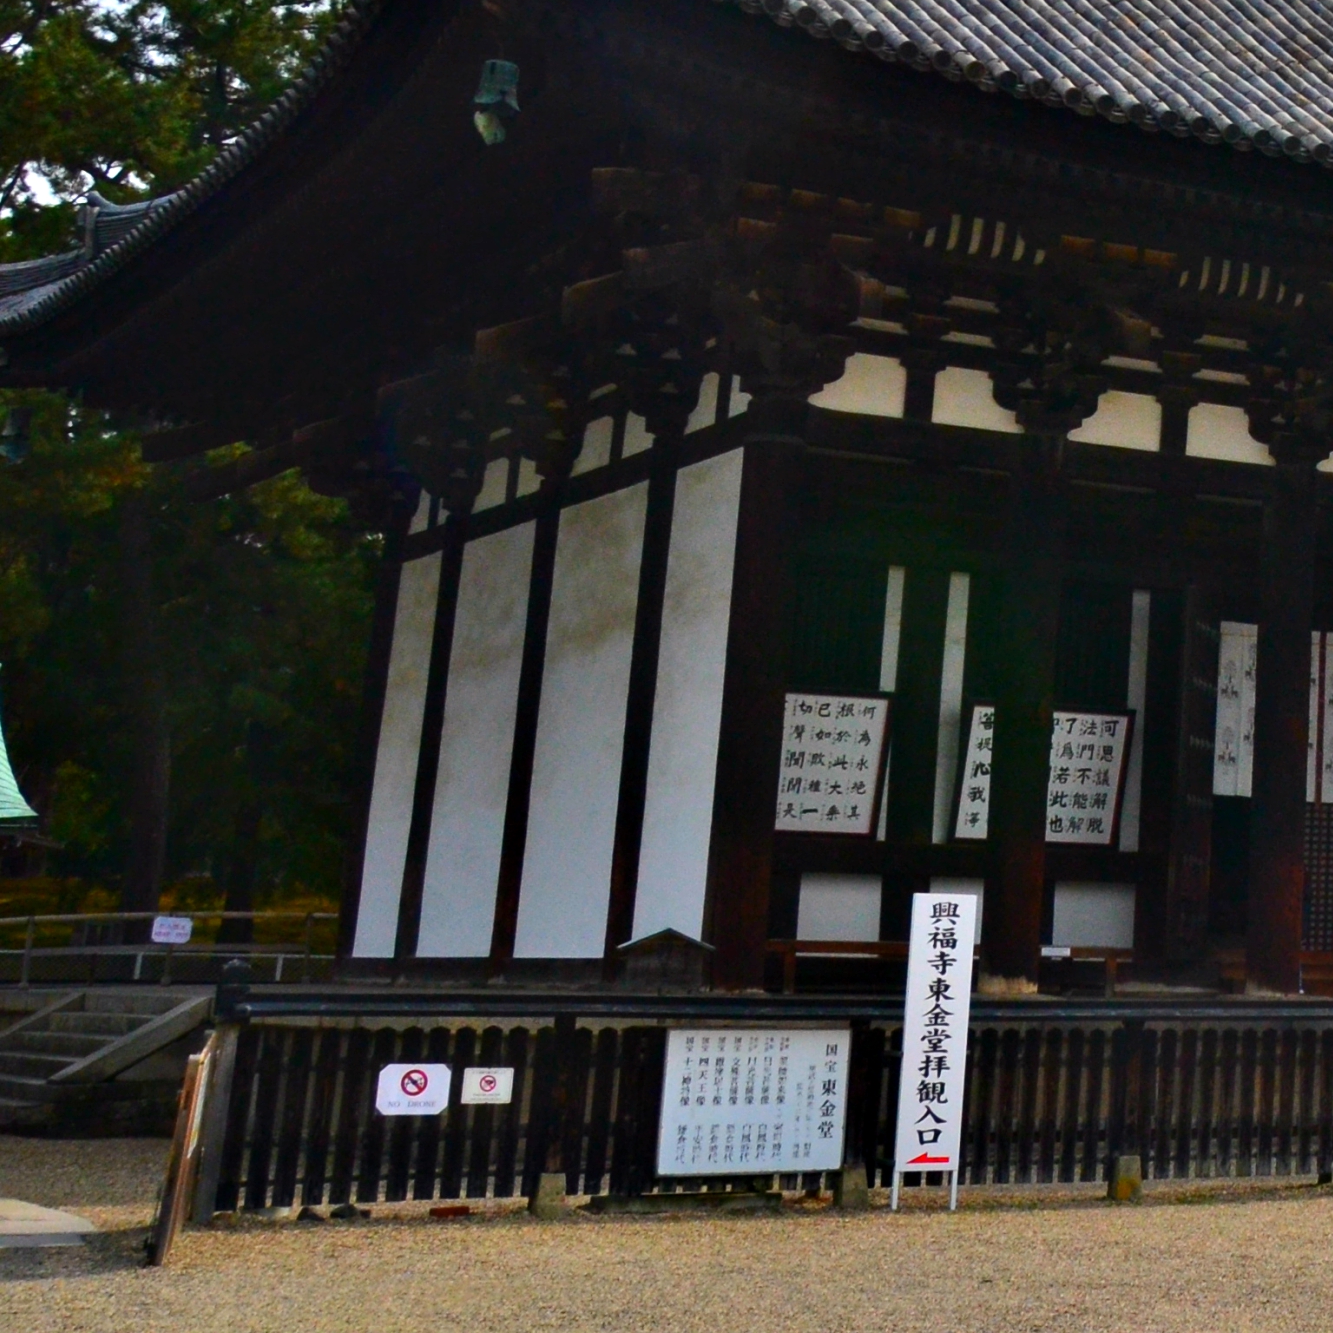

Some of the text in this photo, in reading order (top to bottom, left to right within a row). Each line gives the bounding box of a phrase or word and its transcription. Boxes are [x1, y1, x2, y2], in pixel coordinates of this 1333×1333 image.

[913, 901, 961, 1146] 興福寺東金堂拝観入口
[387, 1100, 437, 1108] NO DRONE
